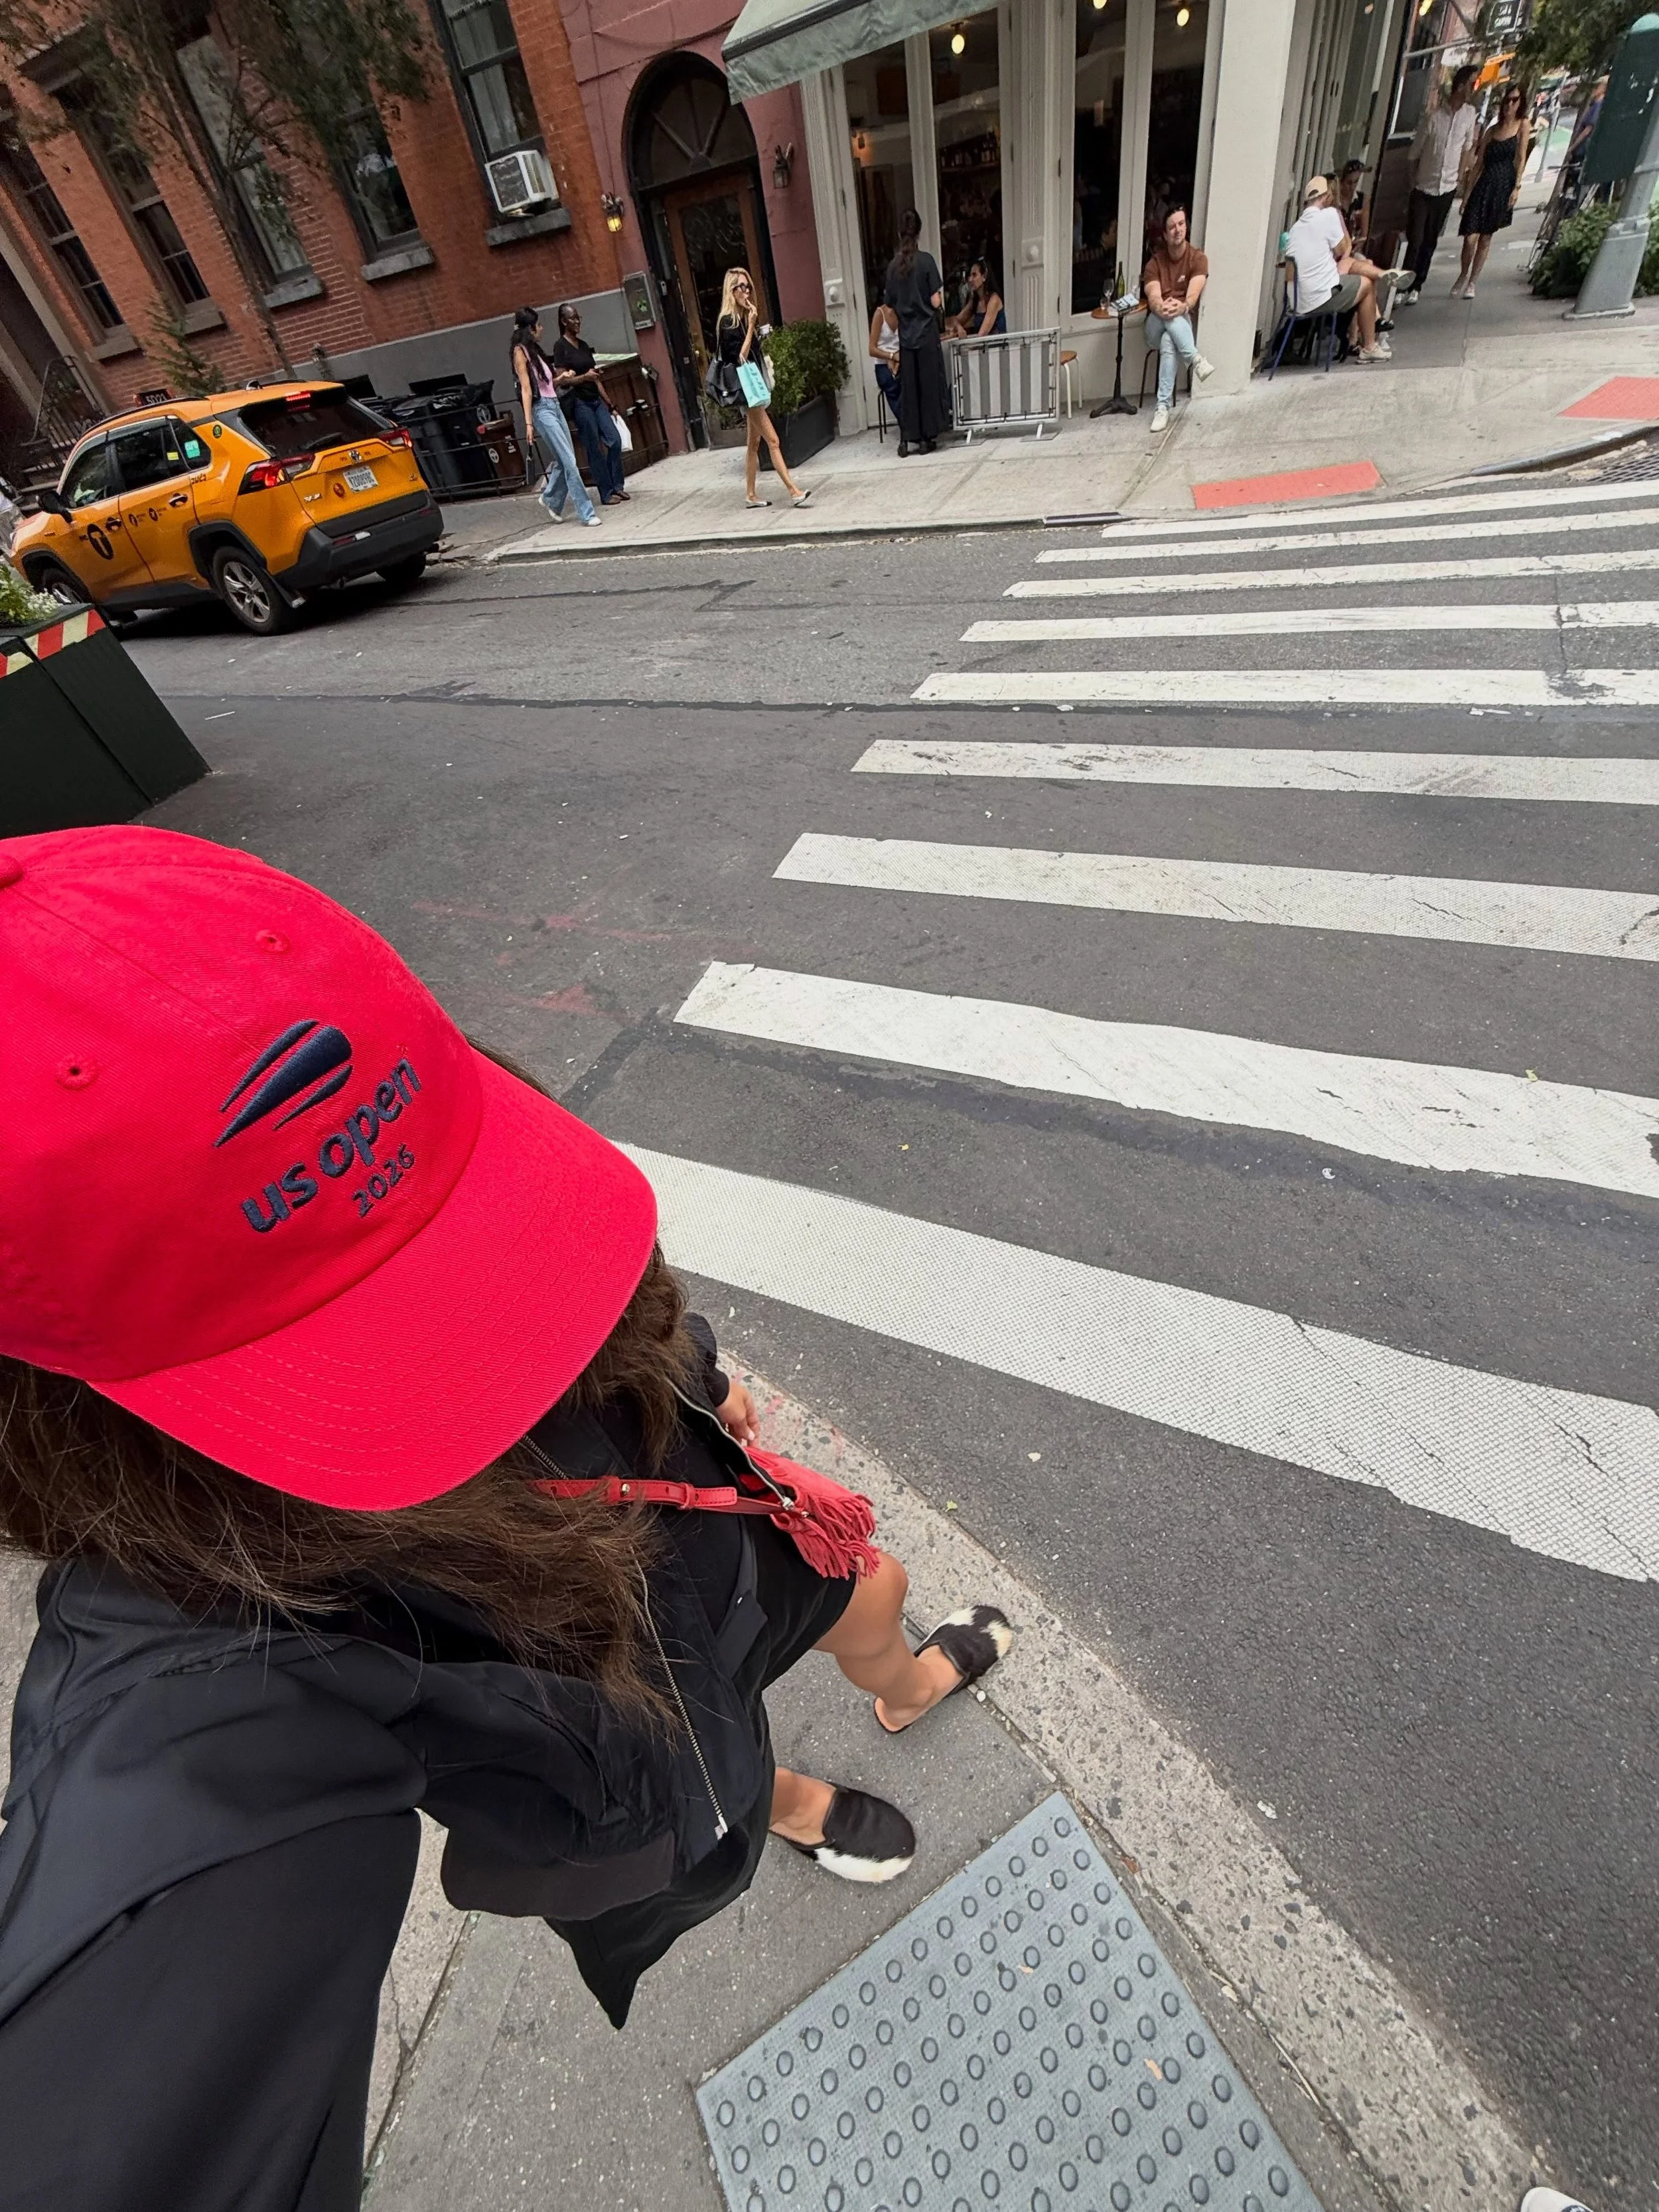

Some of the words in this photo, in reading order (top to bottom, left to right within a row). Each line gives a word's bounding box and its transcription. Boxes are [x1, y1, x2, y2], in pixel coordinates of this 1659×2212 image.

[241, 1161, 319, 1232] us
[319, 1058, 421, 1178] open
[352, 1143, 415, 1217] 2026
